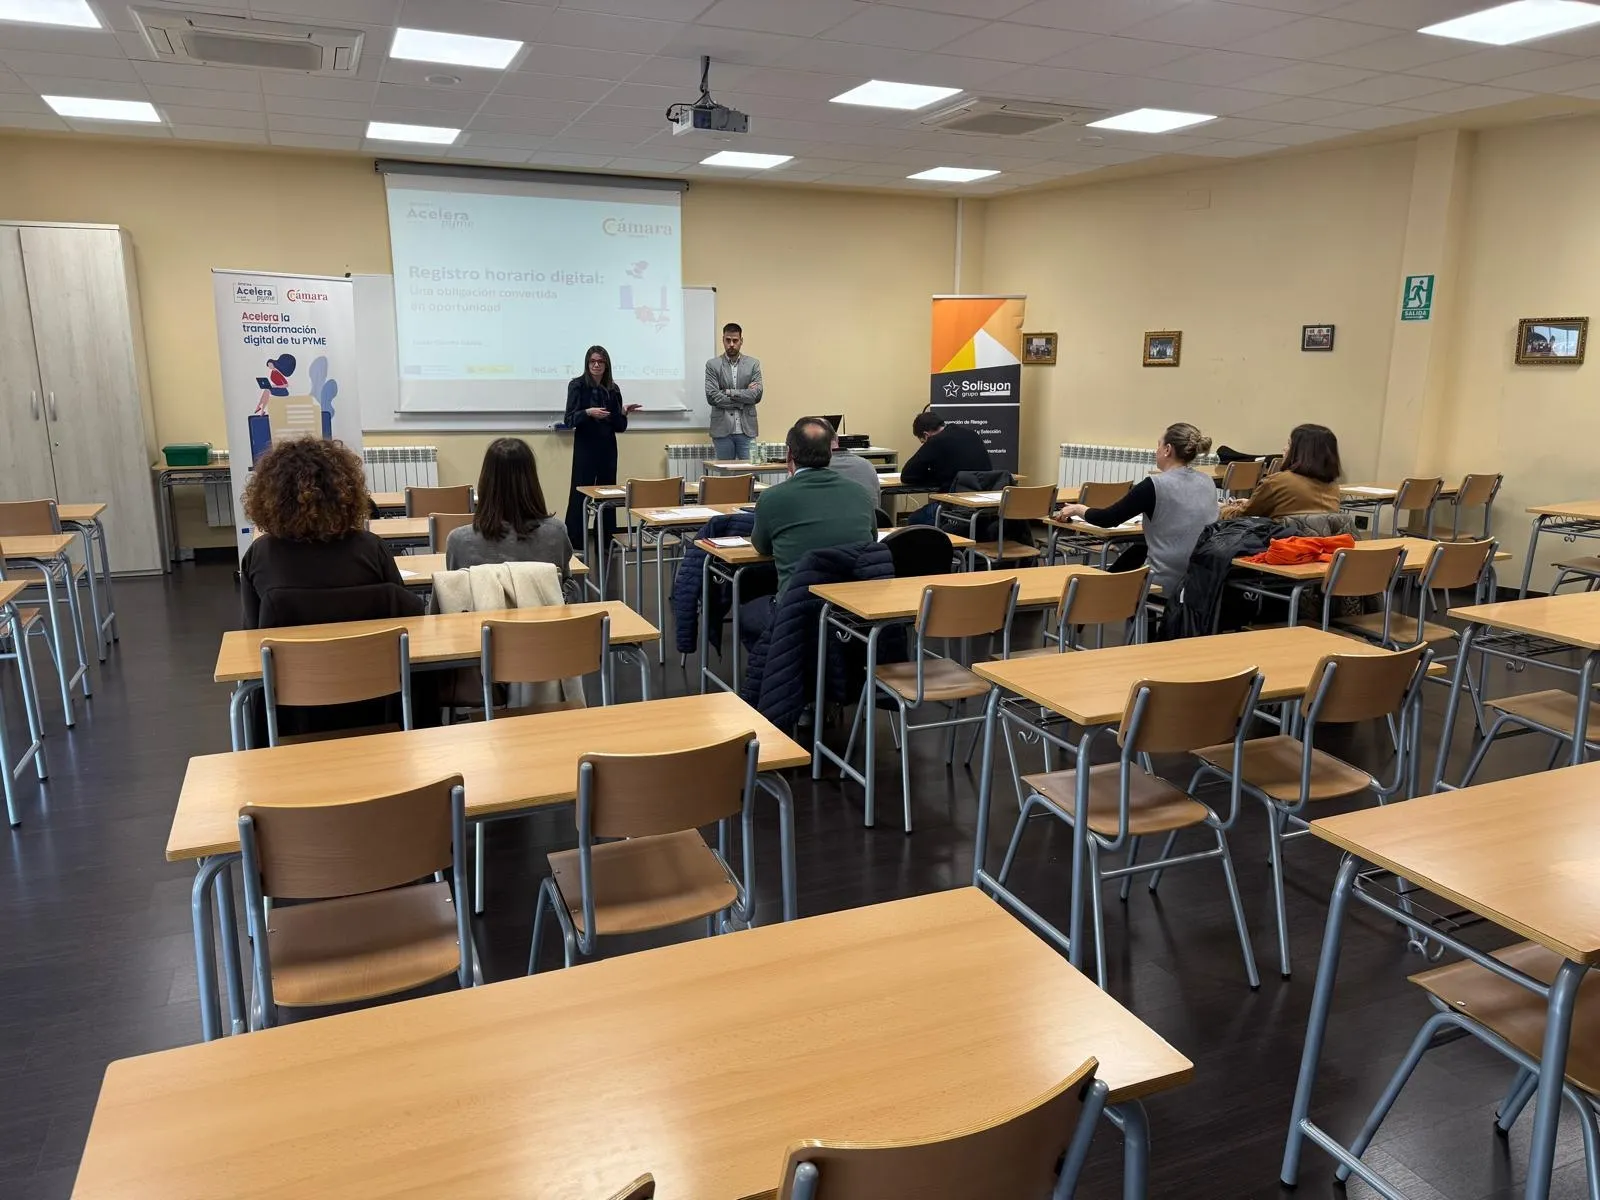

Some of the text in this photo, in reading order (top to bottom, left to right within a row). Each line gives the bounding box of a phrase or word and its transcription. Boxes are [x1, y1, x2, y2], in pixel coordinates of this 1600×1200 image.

[406, 206, 469, 221] Acelera
[602, 217, 672, 236] Cámara
[409, 266, 605, 285] Registro horario digital:
[236, 286, 273, 296] Acelera
[287, 289, 328, 302] Cámara
[499, 289, 559, 300] convertida
[429, 301, 502, 313] oportunidad
[242, 312, 290, 322] Acelera la
[242, 324, 317, 335] transformación
[243, 335, 327, 346] digital de tu PYME
[961, 380, 1011, 393] Solisyon
